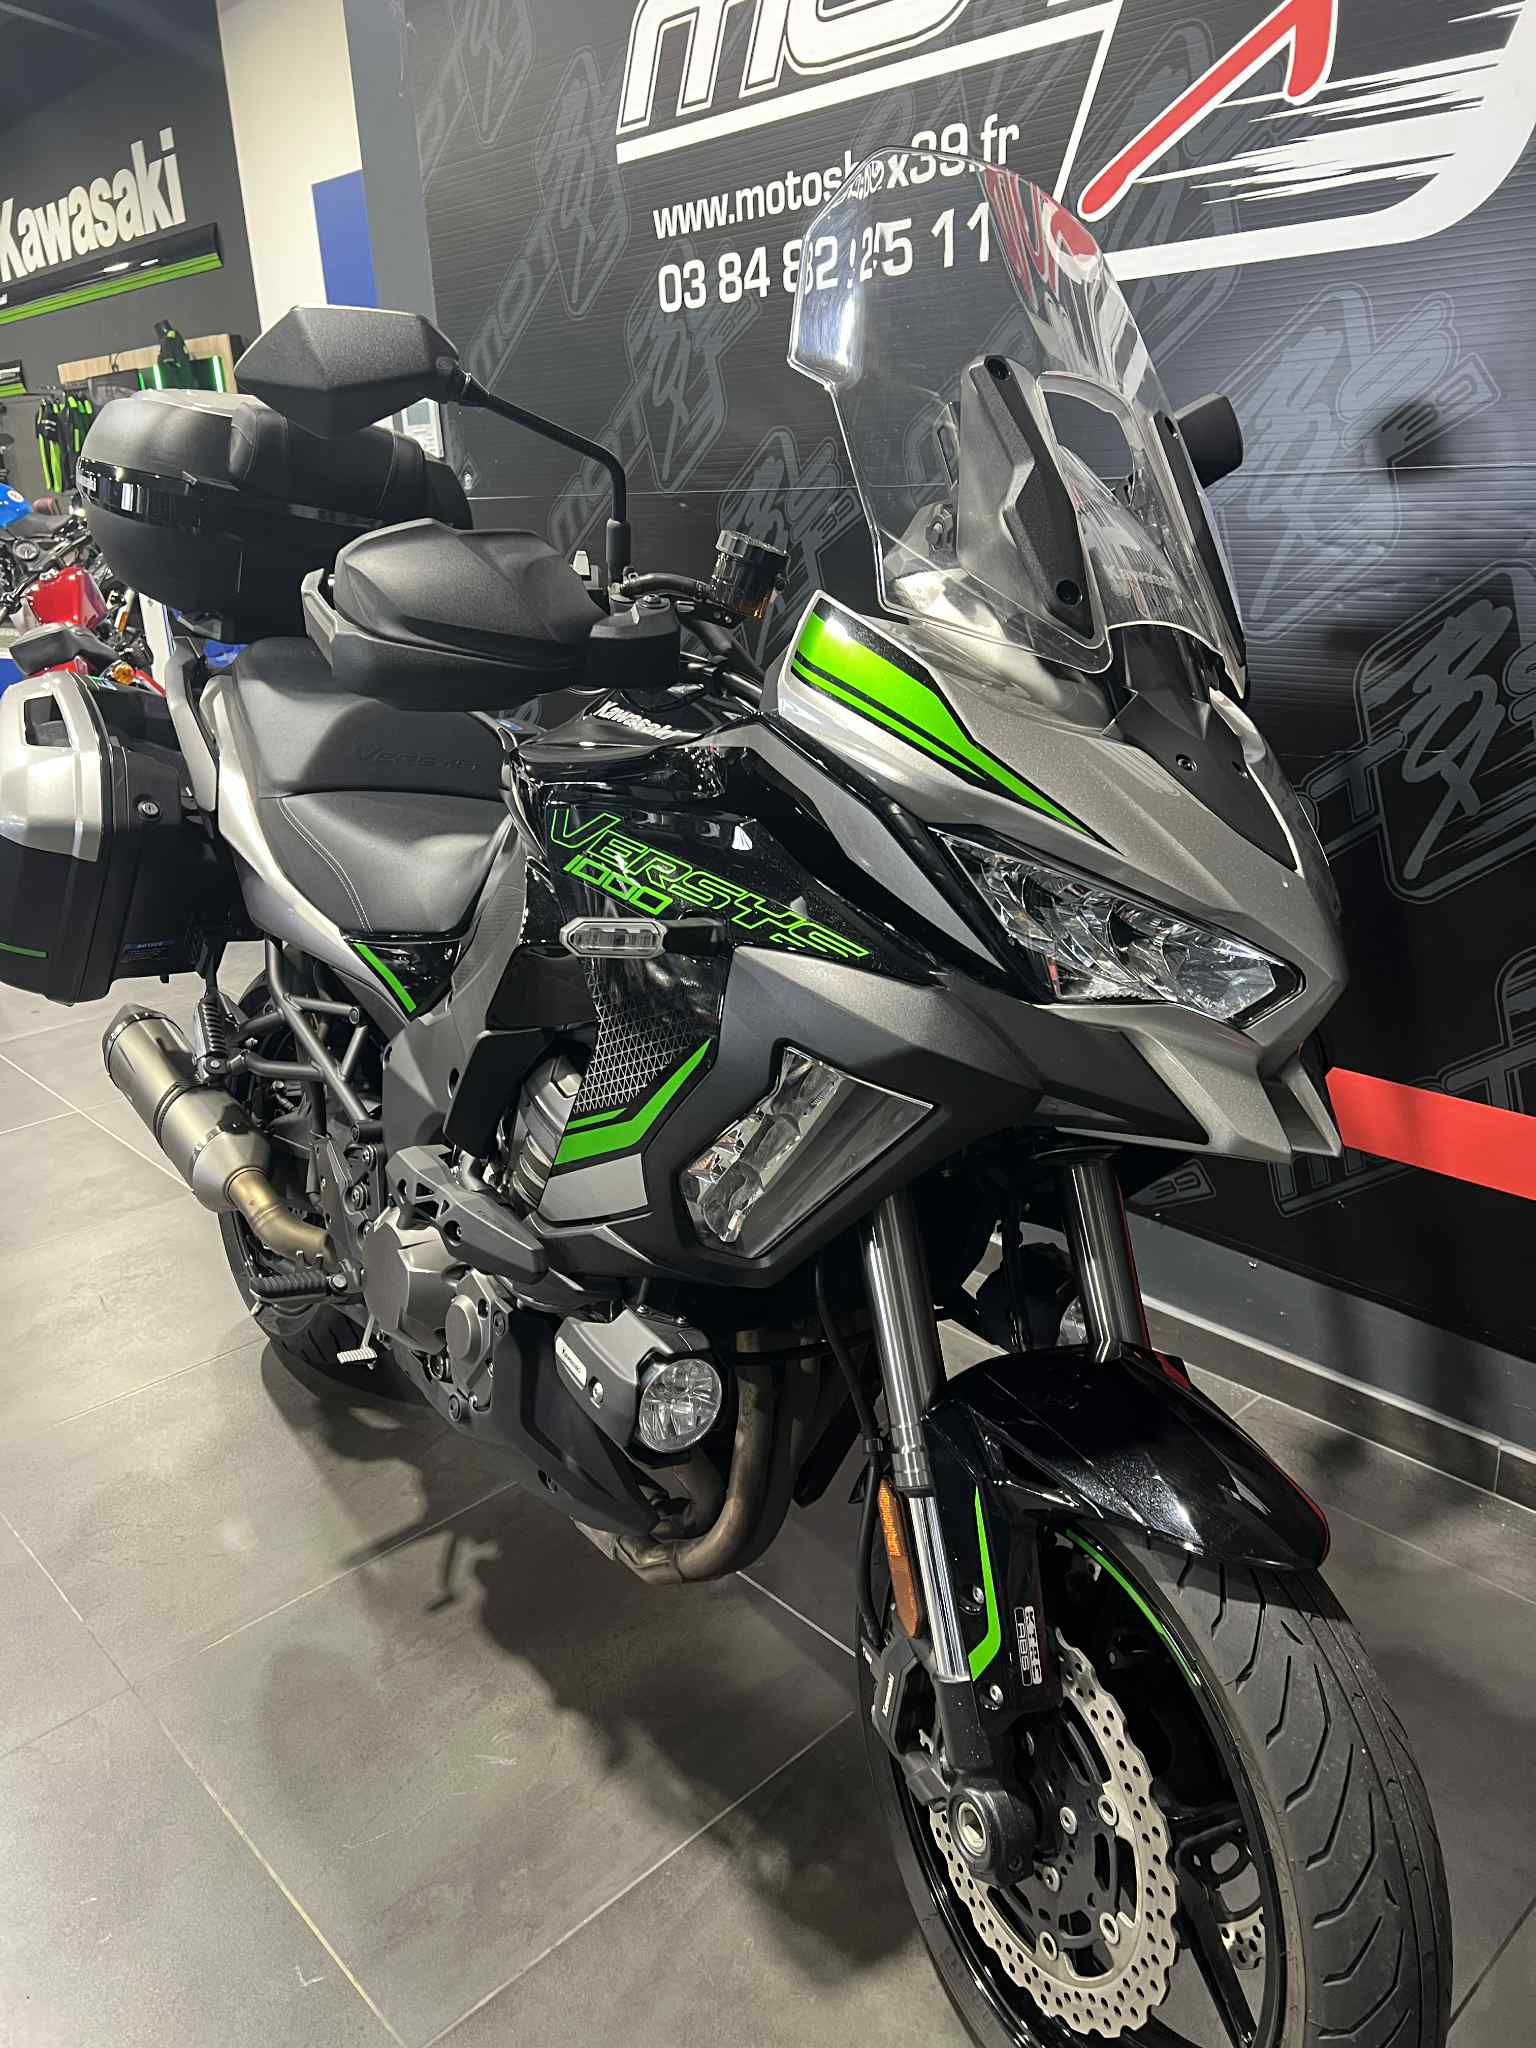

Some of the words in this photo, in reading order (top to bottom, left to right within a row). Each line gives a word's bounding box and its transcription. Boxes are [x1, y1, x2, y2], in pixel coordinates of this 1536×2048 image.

[0, 127, 186, 283] Kawasaki
[658, 260, 707, 313] 03
[717, 246, 771, 303] 84
[782, 235, 840, 295] 82
[593, 701, 674, 740] Kawasaki
[551, 808, 870, 959] VERSYS
[563, 854, 673, 916] 1000
